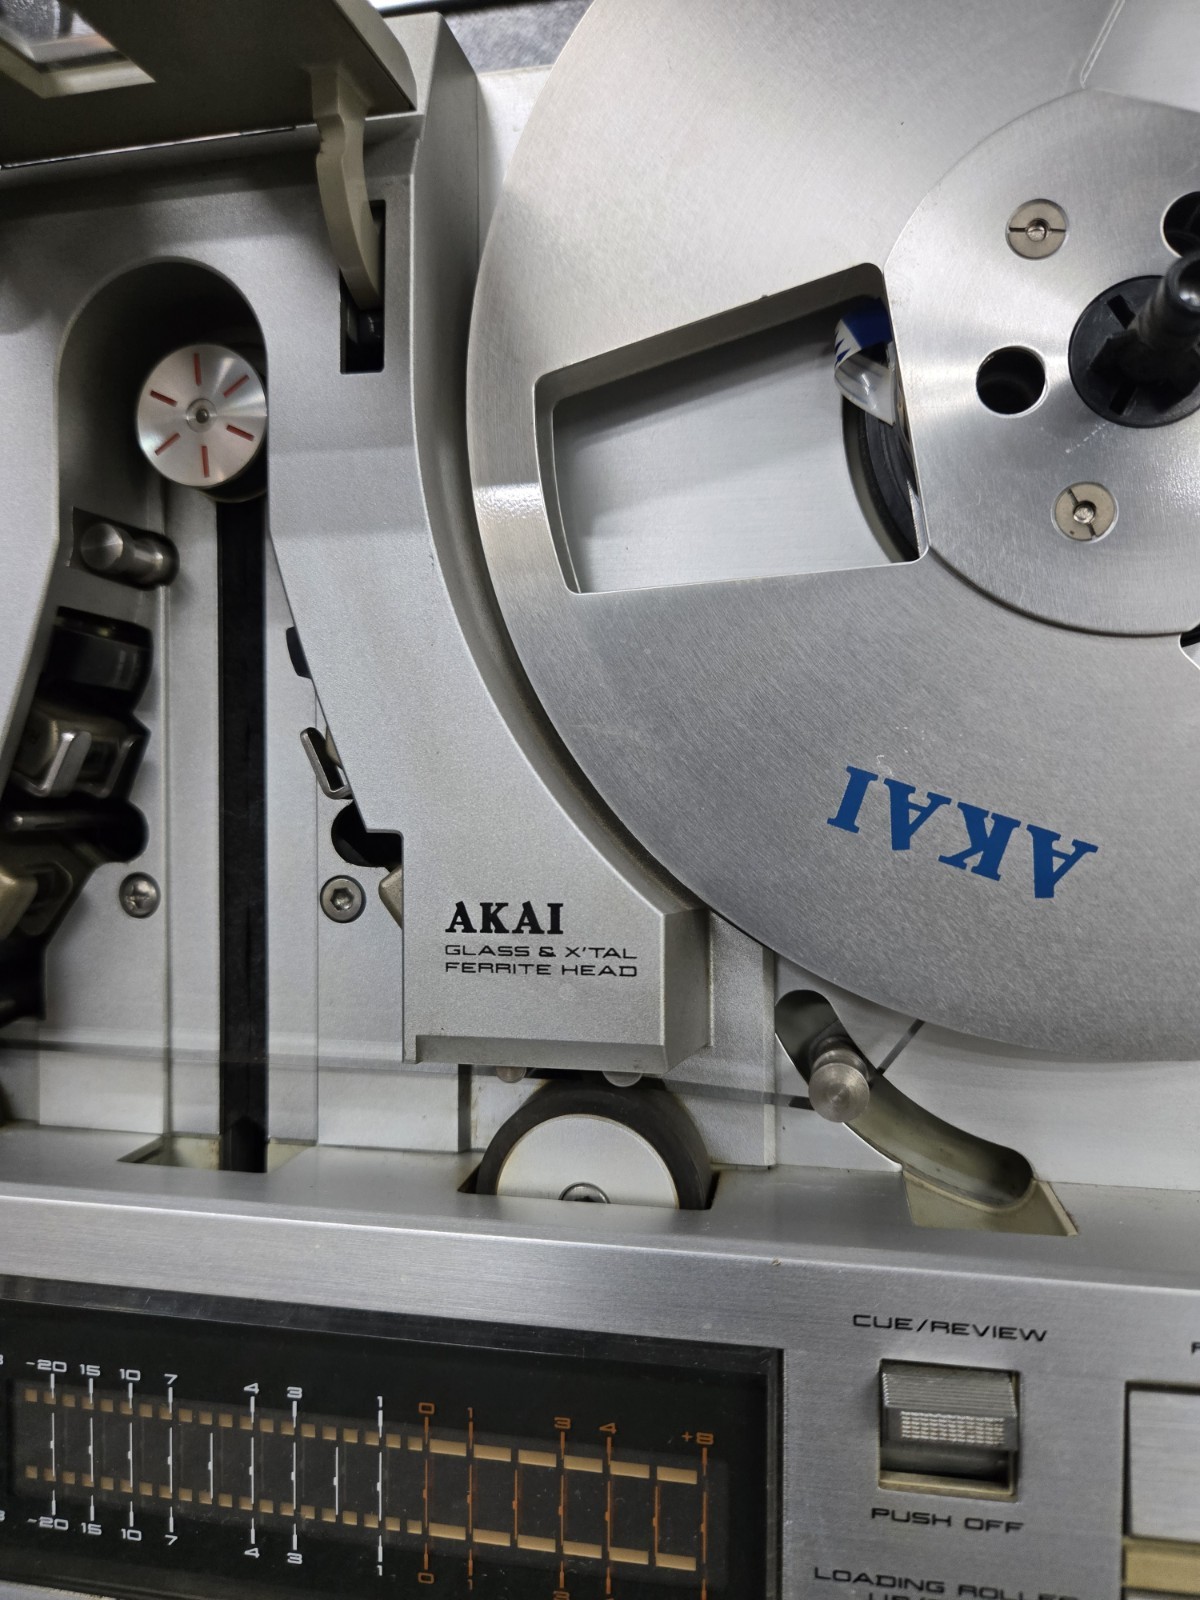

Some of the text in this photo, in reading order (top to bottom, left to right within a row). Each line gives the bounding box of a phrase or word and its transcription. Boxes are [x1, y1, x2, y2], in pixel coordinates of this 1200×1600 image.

[826, 765, 1099, 899] AKAI
[444, 900, 564, 935] AKAI
[444, 944, 638, 960] GLASS & X'TAL
[445, 961, 638, 978] FERRITE HEAD
[852, 1314, 1047, 1342] CUE/REVIEW
[26, 1358, 68, 1373] -20
[79, 1363, 101, 1377] 15
[119, 1368, 141, 1382] 10
[164, 1373, 178, 1385] 7
[243, 1382, 260, 1395] 4
[286, 1386, 303, 1399] 3
[418, 1402, 435, 1415] 0
[554, 1416, 571, 1430] 3
[599, 1422, 617, 1435] 4
[682, 1431, 714, 1445] +8
[870, 1507, 1024, 1534] PUSH OFF
[27, 1516, 69, 1531] -20
[80, 1522, 102, 1536] 15
[120, 1528, 142, 1542] 10
[164, 1534, 178, 1546] 7
[243, 1547, 260, 1559] 4
[286, 1552, 303, 1565] 3
[417, 1572, 435, 1585] 0
[814, 1566, 945, 1593] LOADING
